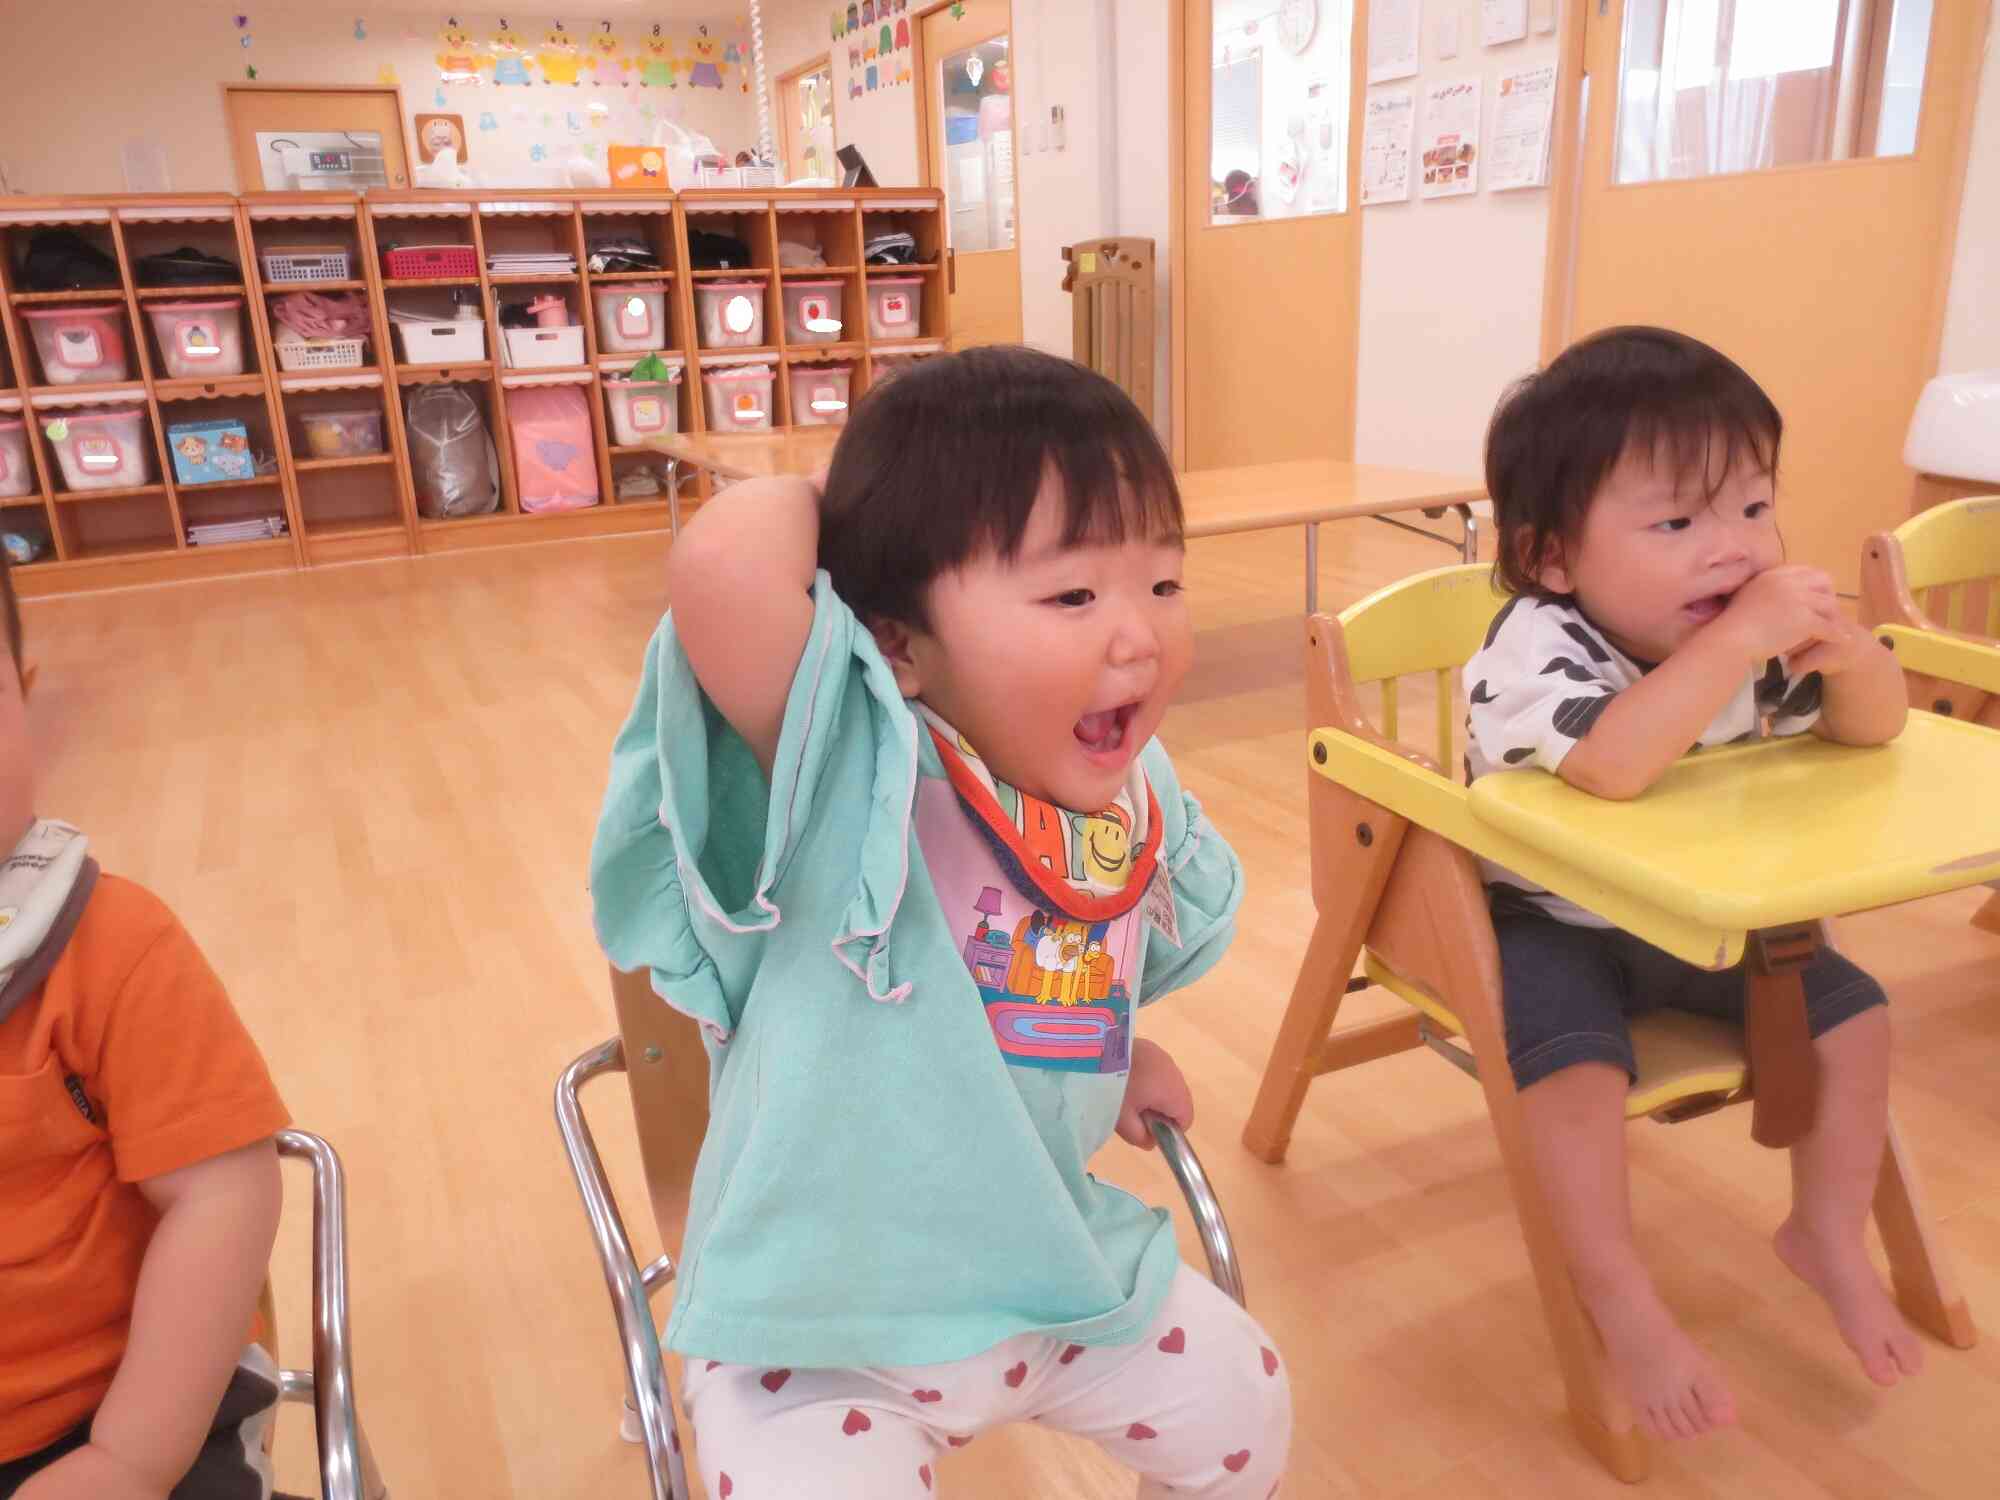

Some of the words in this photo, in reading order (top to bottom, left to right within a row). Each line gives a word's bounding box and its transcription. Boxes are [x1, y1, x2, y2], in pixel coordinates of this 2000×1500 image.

[500, 18, 509, 31] 5
[601, 21, 611, 33] 7
[653, 24, 660, 36] 8
[699, 25, 708, 37] 9
